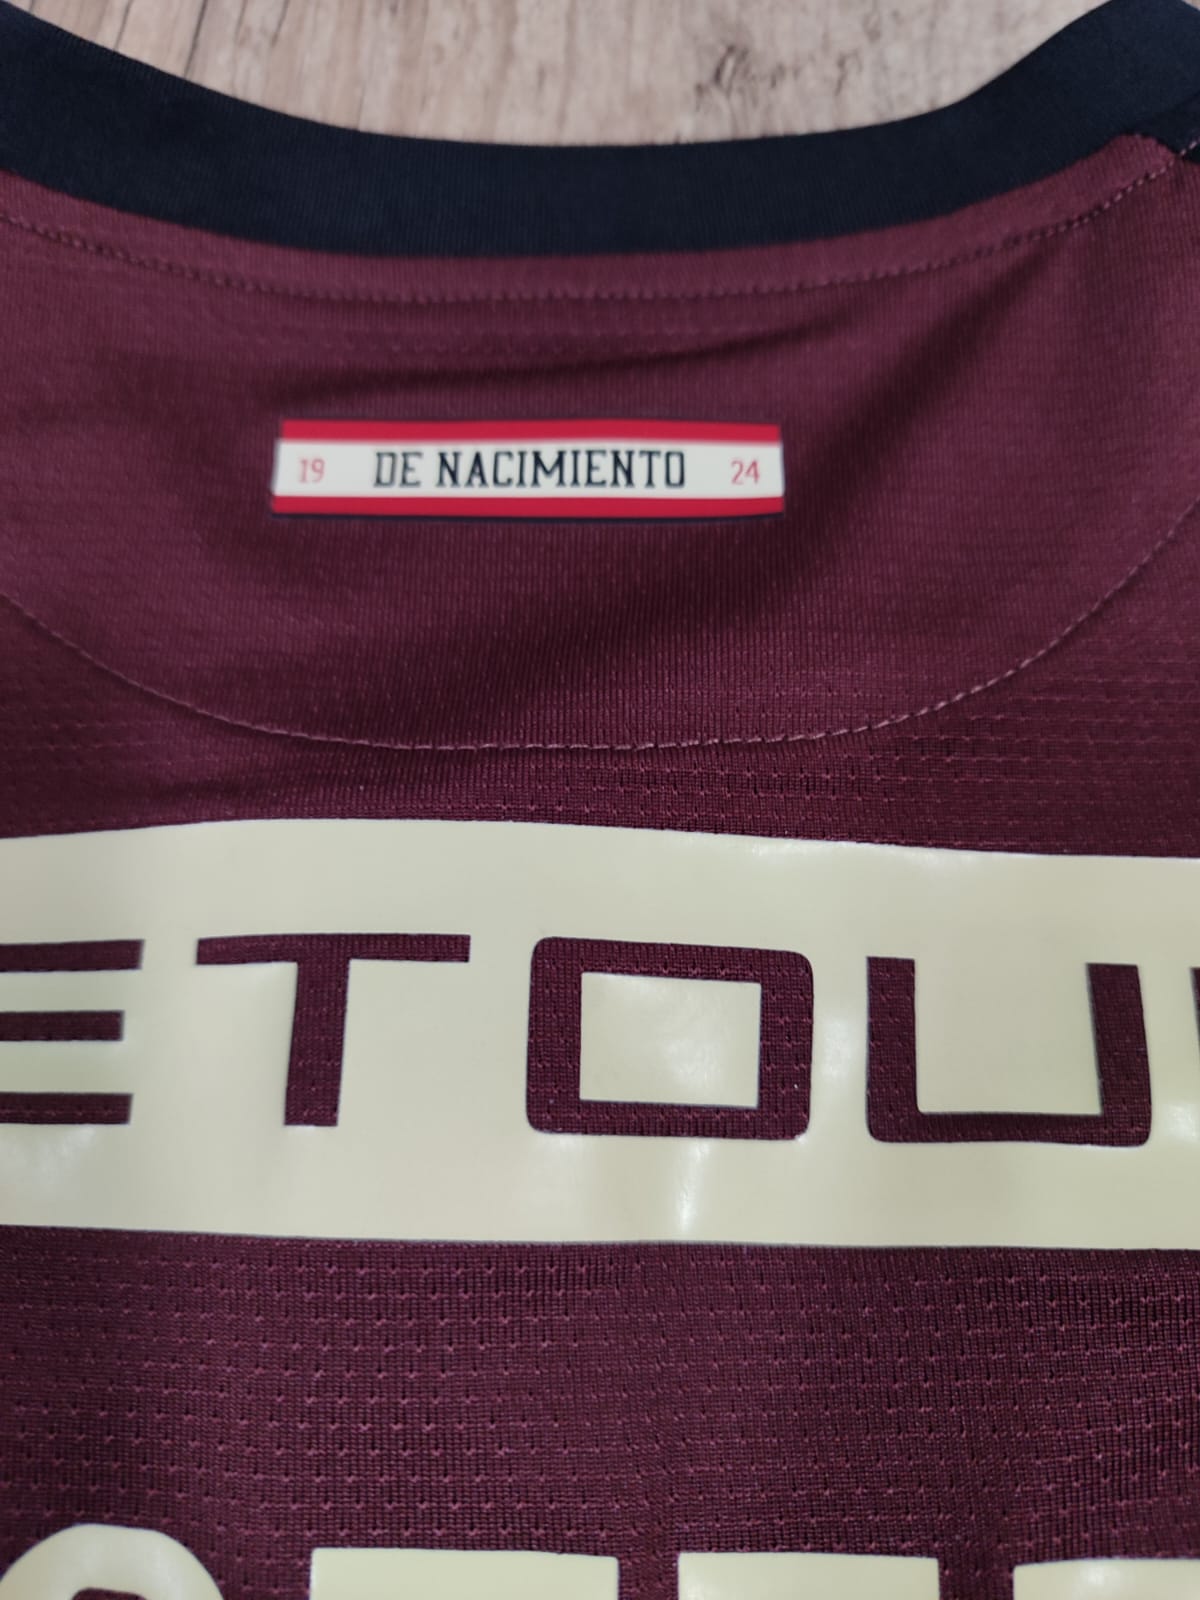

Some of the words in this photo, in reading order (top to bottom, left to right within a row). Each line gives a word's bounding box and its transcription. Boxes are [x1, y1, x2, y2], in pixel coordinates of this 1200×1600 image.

[299, 458, 325, 483] 19
[373, 451, 422, 489] DE
[435, 450, 686, 489] NACIMIENTO
[730, 460, 761, 484] 24
[0, 932, 1200, 1147] ETOU
